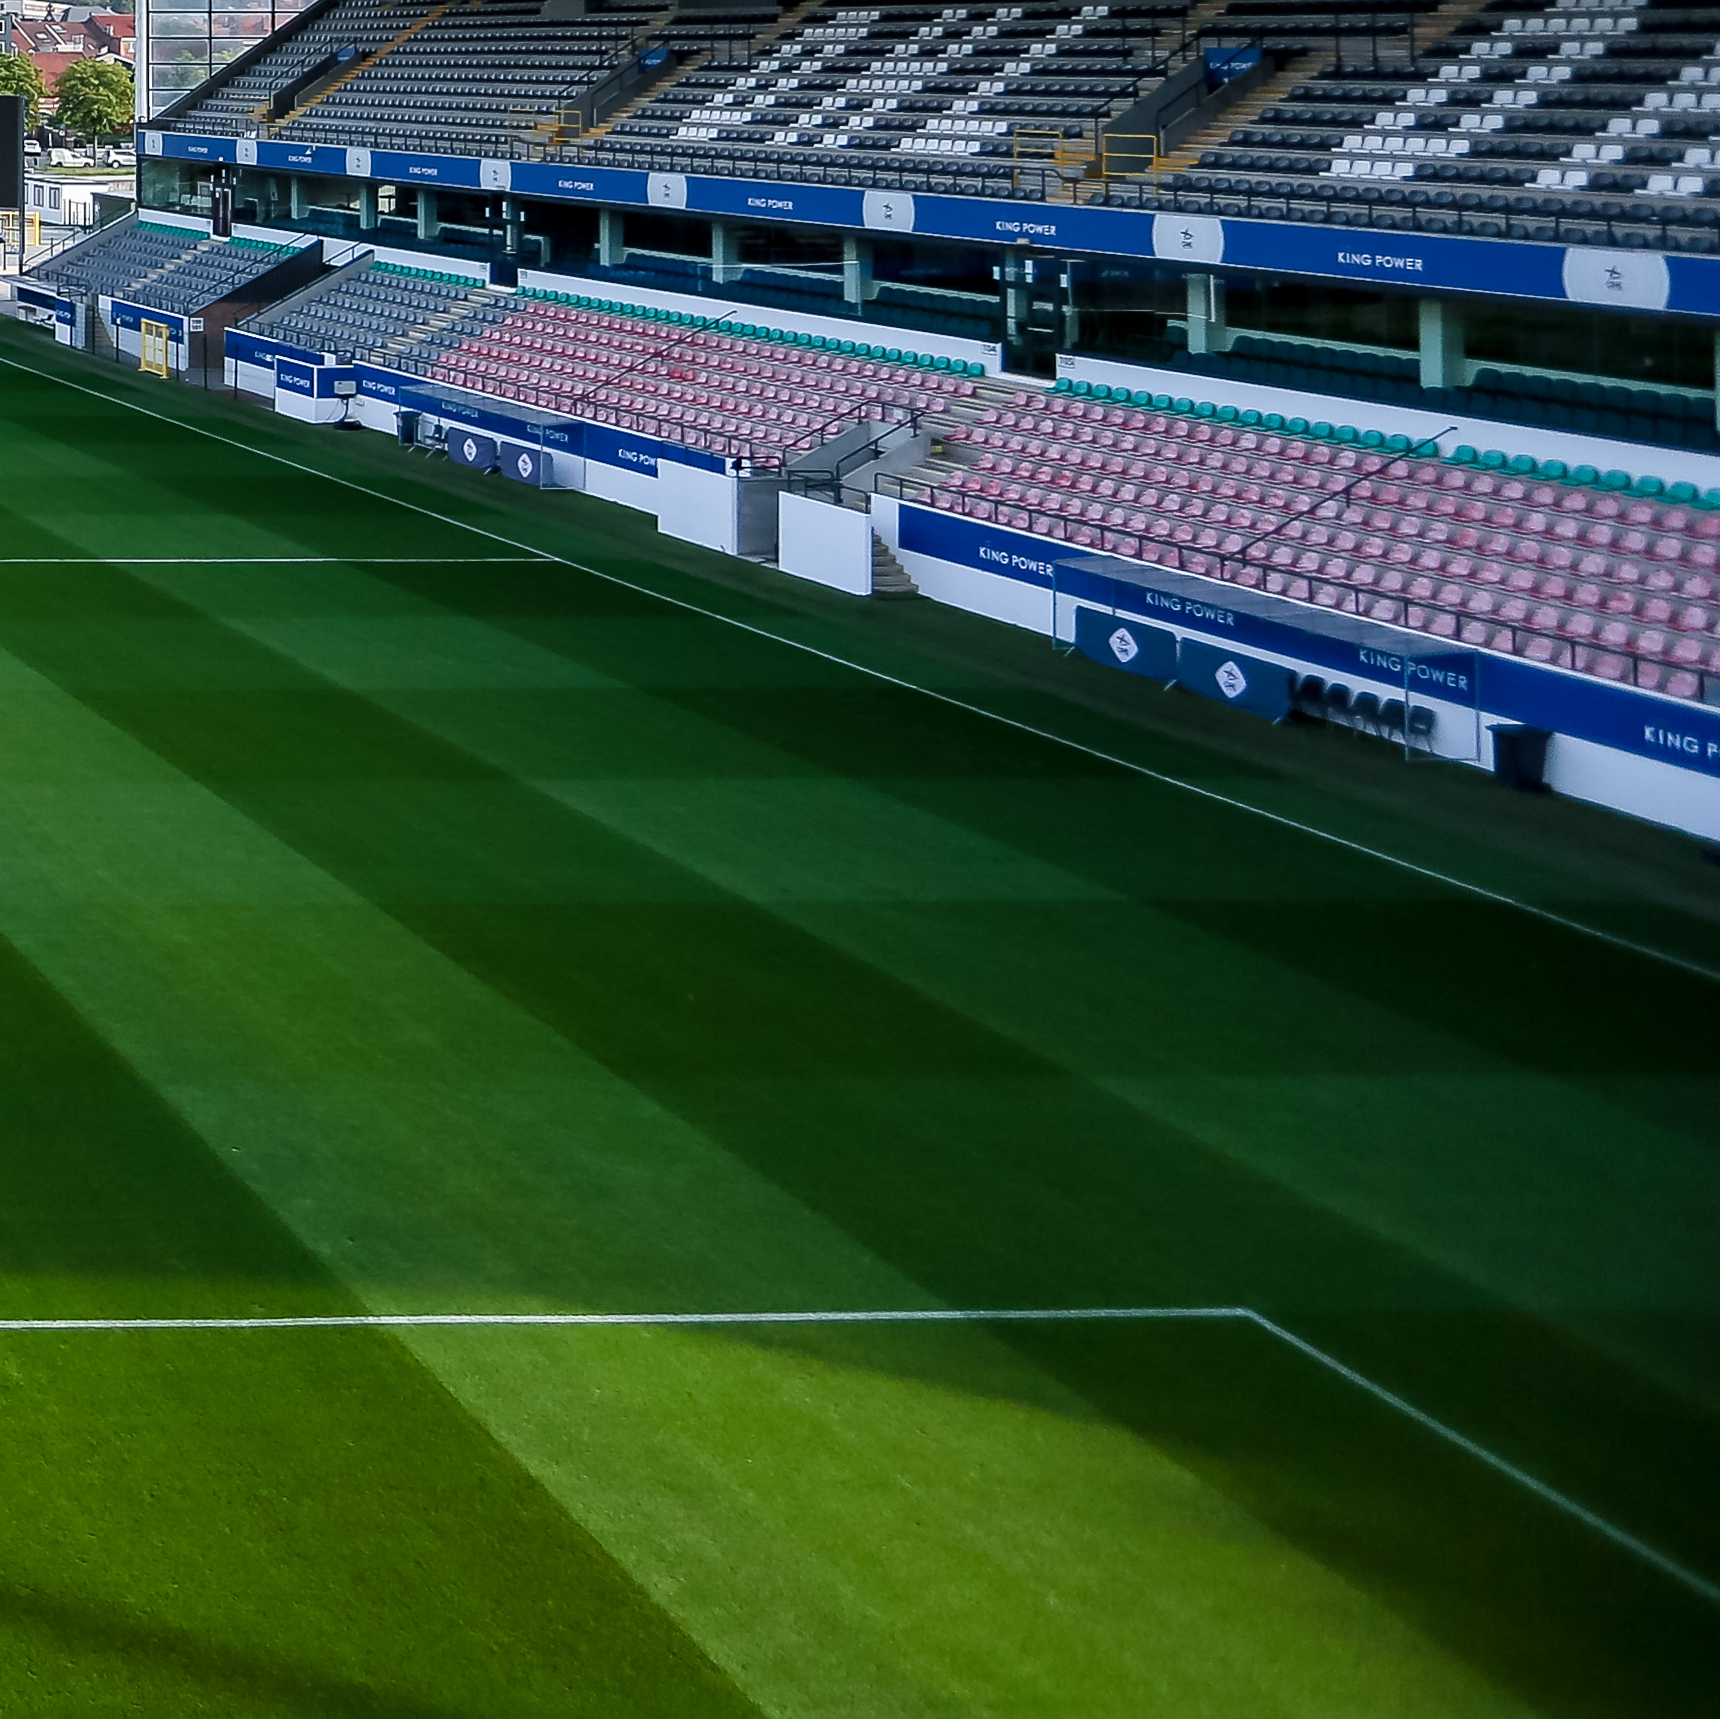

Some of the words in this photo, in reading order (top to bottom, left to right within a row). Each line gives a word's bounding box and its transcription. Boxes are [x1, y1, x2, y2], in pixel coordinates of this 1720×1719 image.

[995, 221, 1020, 233] KING
[1022, 222, 1056, 237] POWER
[1337, 252, 1372, 266] KING
[1375, 255, 1423, 272] POWER
[618, 447, 637, 461] KING
[979, 546, 1009, 564] KING
[1012, 554, 1054, 577] POWER
[1145, 591, 1181, 611] KING
[1185, 600, 1235, 627] POWER
[1359, 648, 1402, 672] KING
[1407, 662, 1468, 691] POWER
[1644, 724, 1699, 754] KING
